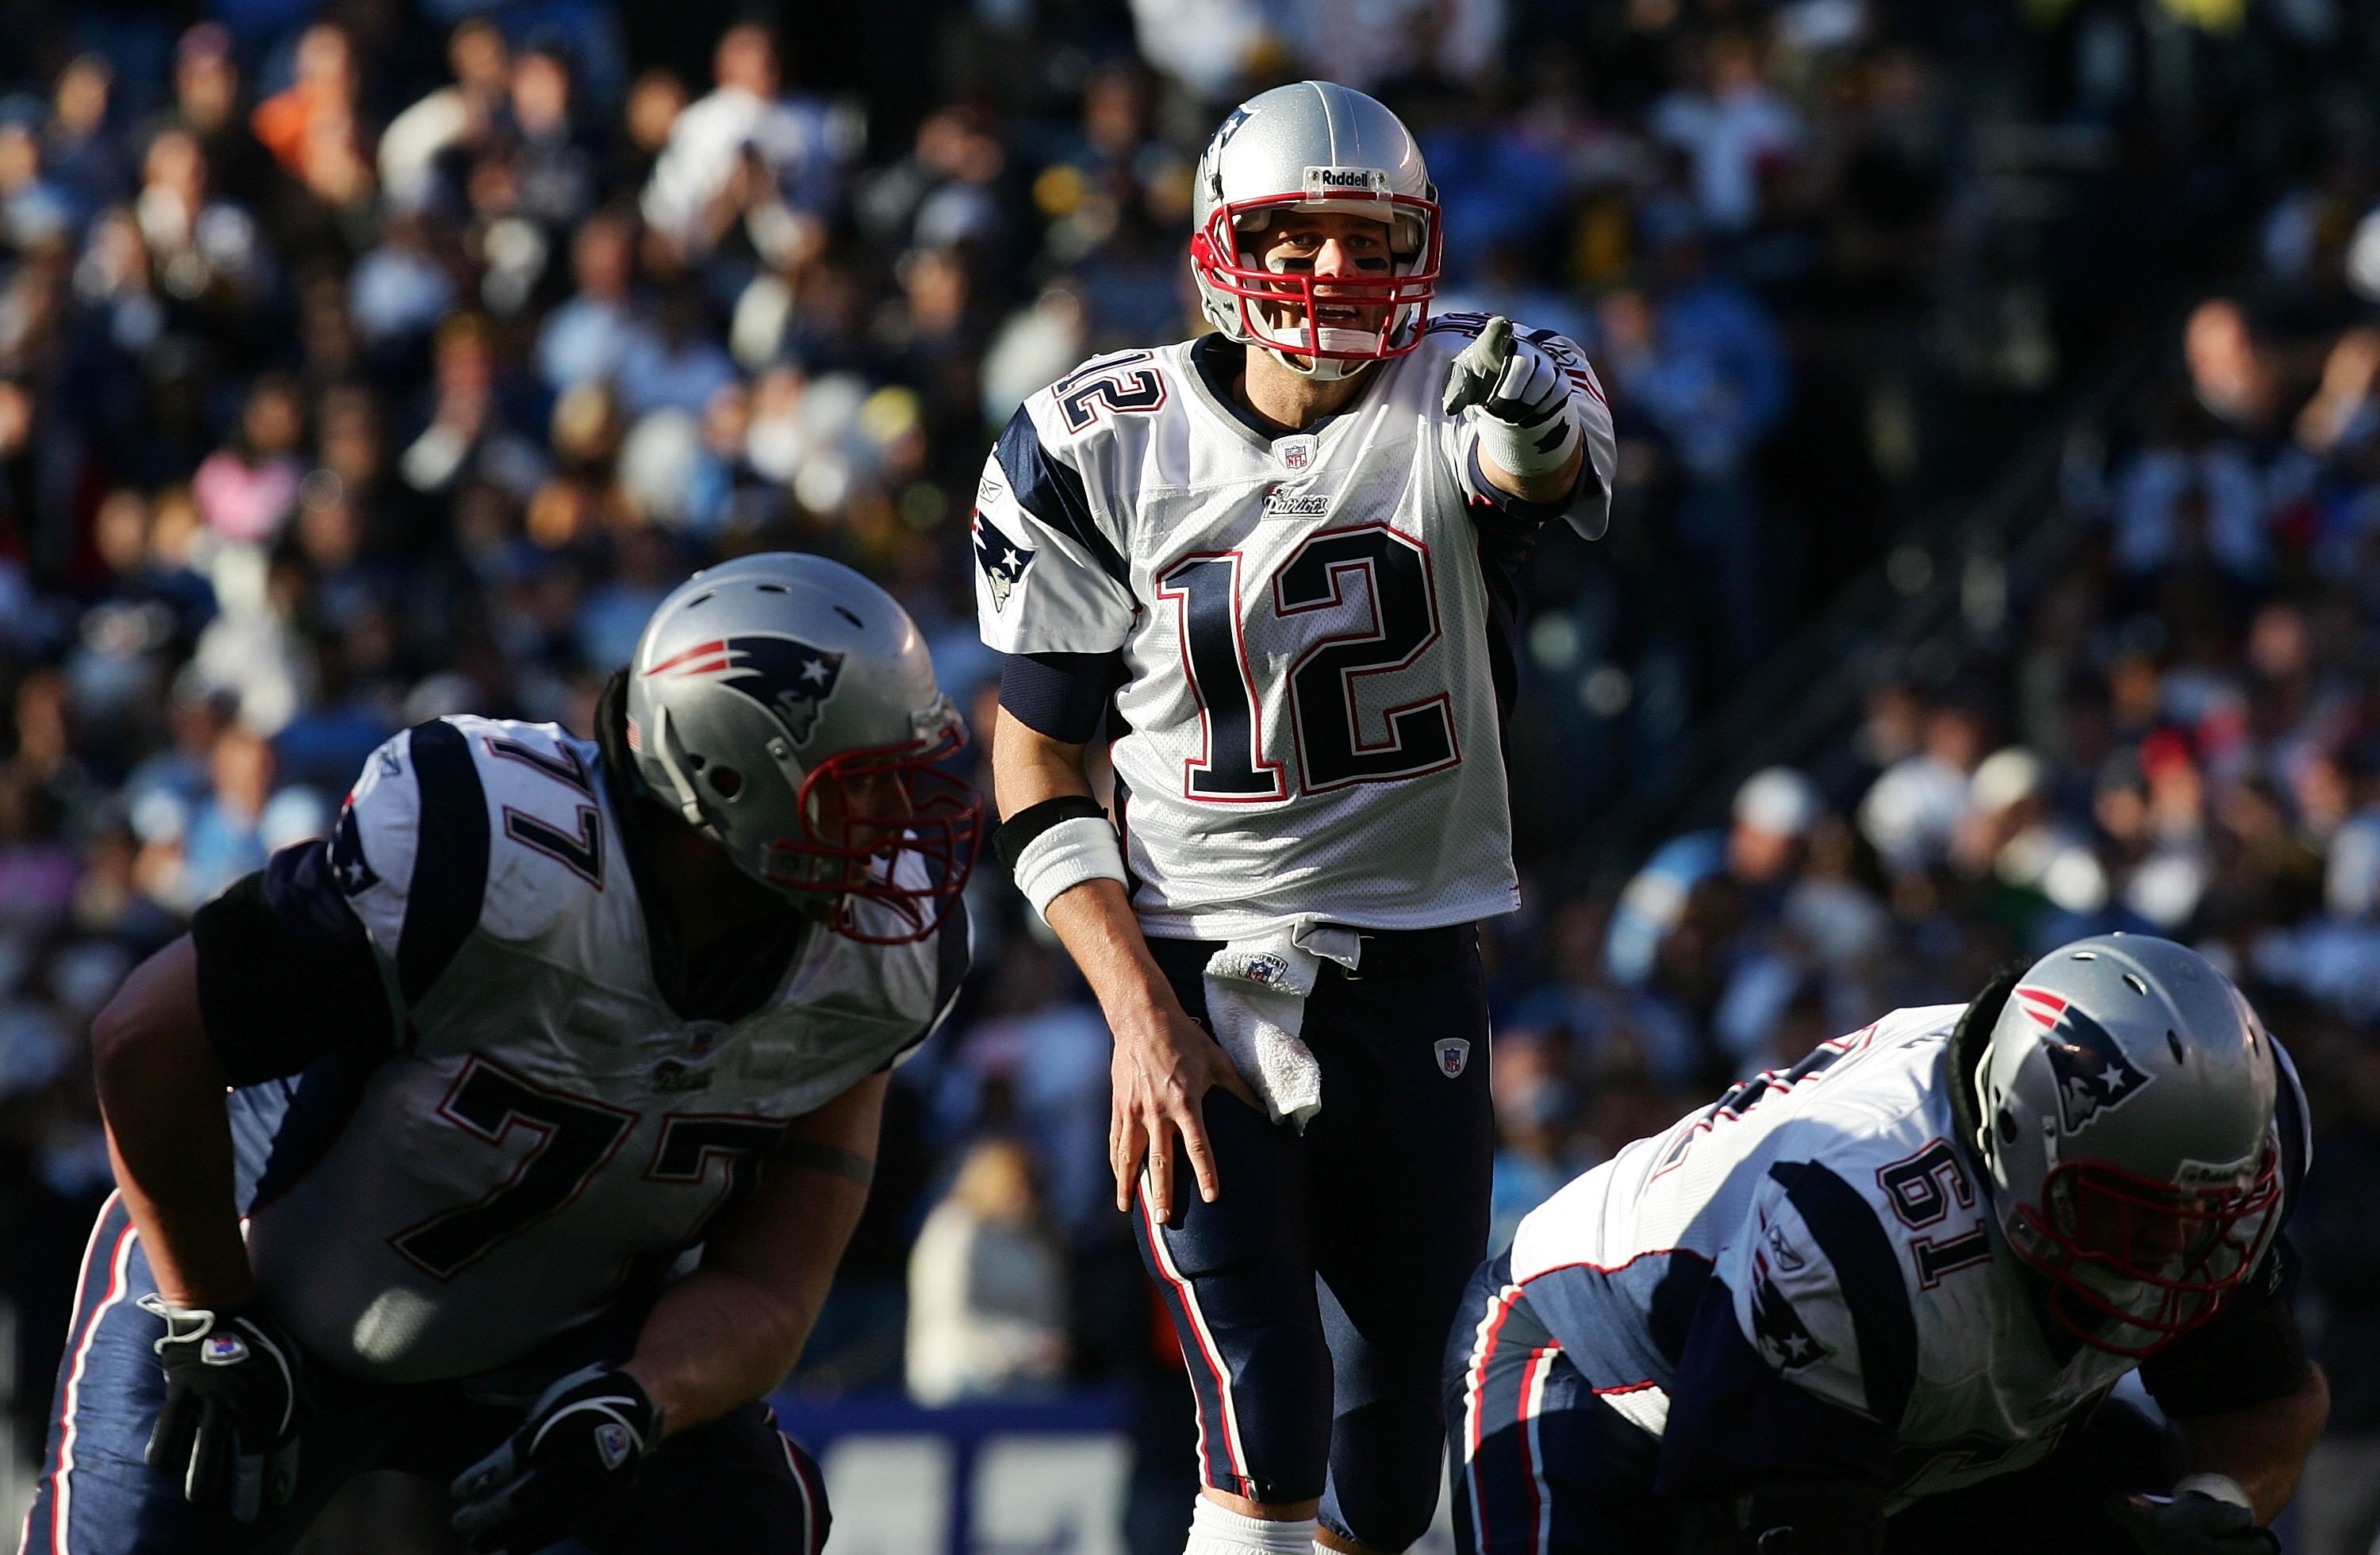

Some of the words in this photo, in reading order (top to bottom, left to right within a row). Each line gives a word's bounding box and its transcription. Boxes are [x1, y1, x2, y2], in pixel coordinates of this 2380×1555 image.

[1322, 170, 1368, 187] Riddell
[1051, 351, 1167, 436] 12
[1262, 493, 1328, 519] Patriots
[1285, 455, 1307, 466] NFL
[1156, 521, 1462, 803] 12
[482, 736, 605, 893] 77
[386, 1052, 790, 1284] 77
[1876, 1137, 1994, 1292] 61
